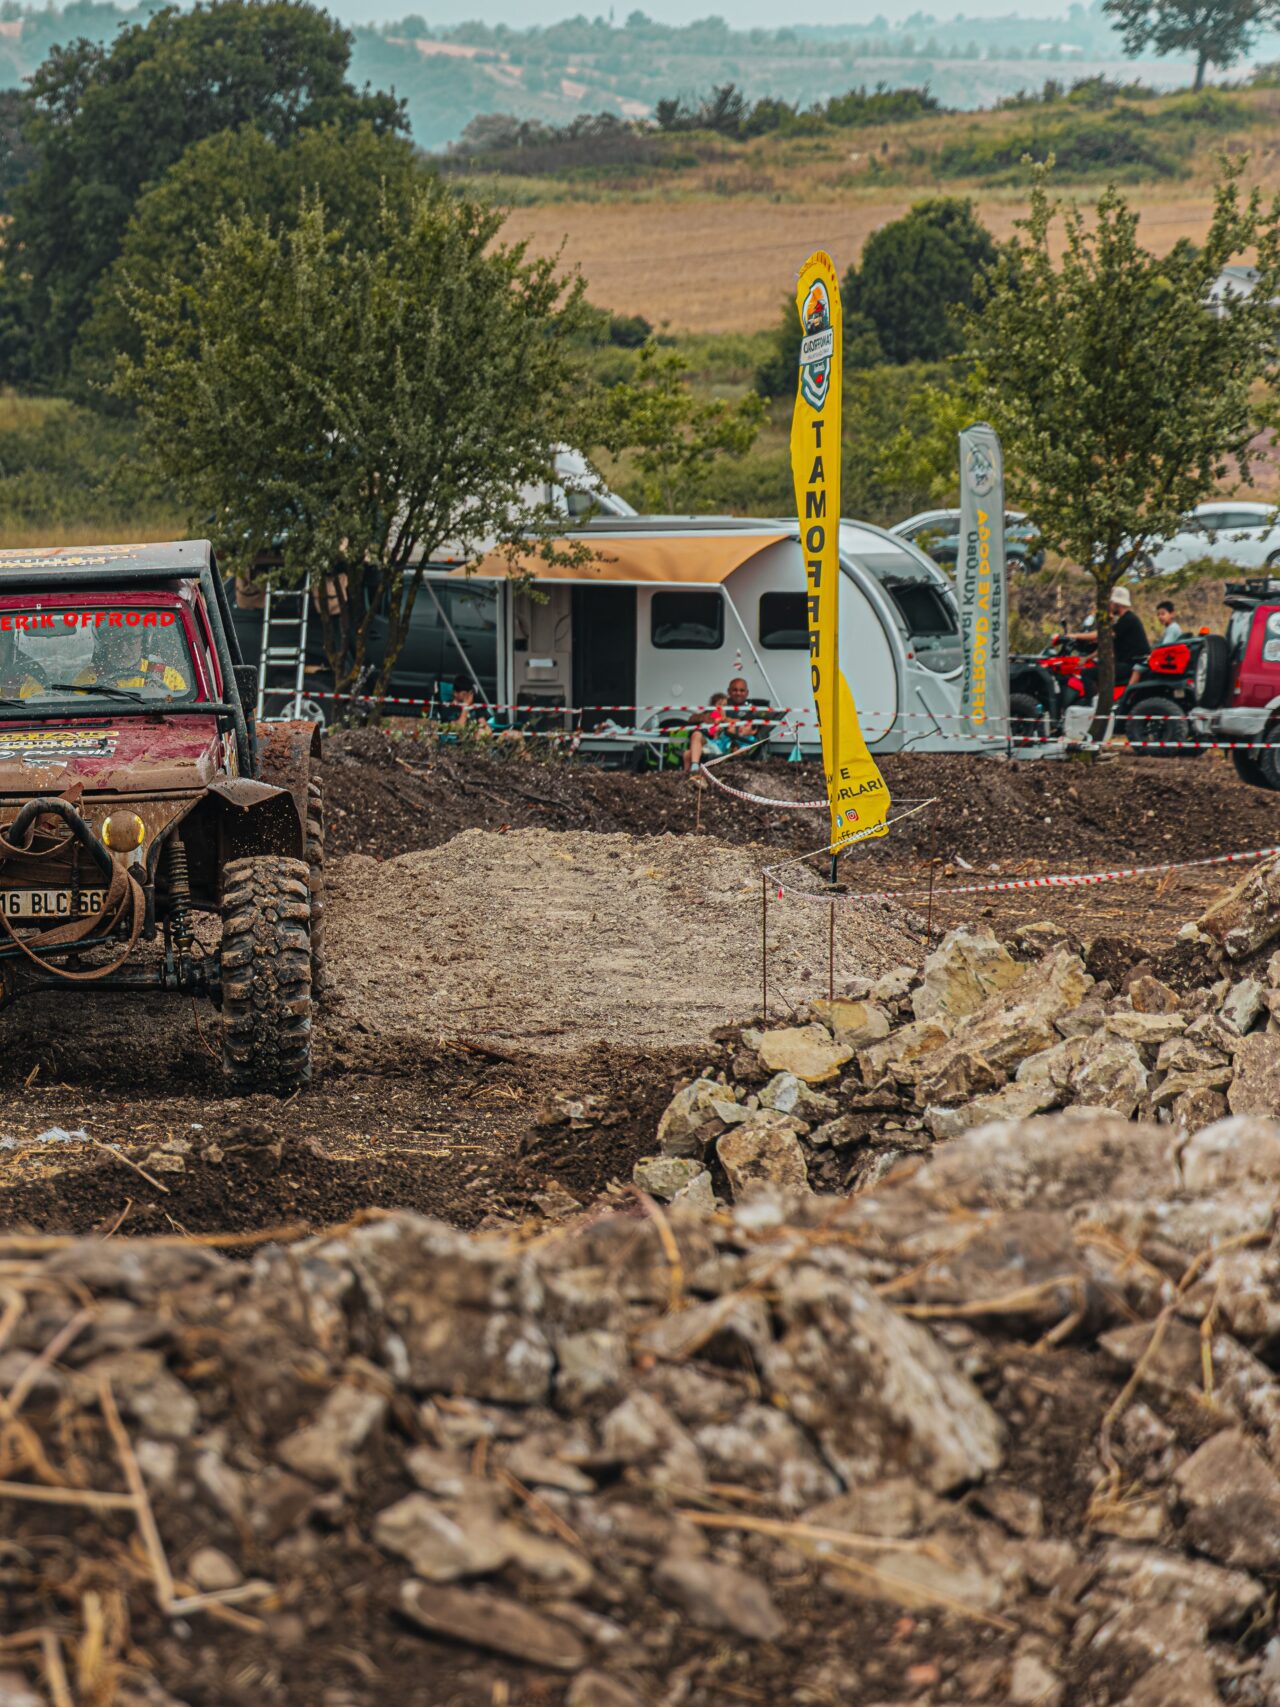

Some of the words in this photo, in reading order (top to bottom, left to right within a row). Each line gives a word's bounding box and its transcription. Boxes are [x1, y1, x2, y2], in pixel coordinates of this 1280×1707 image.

[63, 611, 176, 628] OFFROAD
[0, 892, 21, 914] 16
[31, 892, 67, 914] BLC
